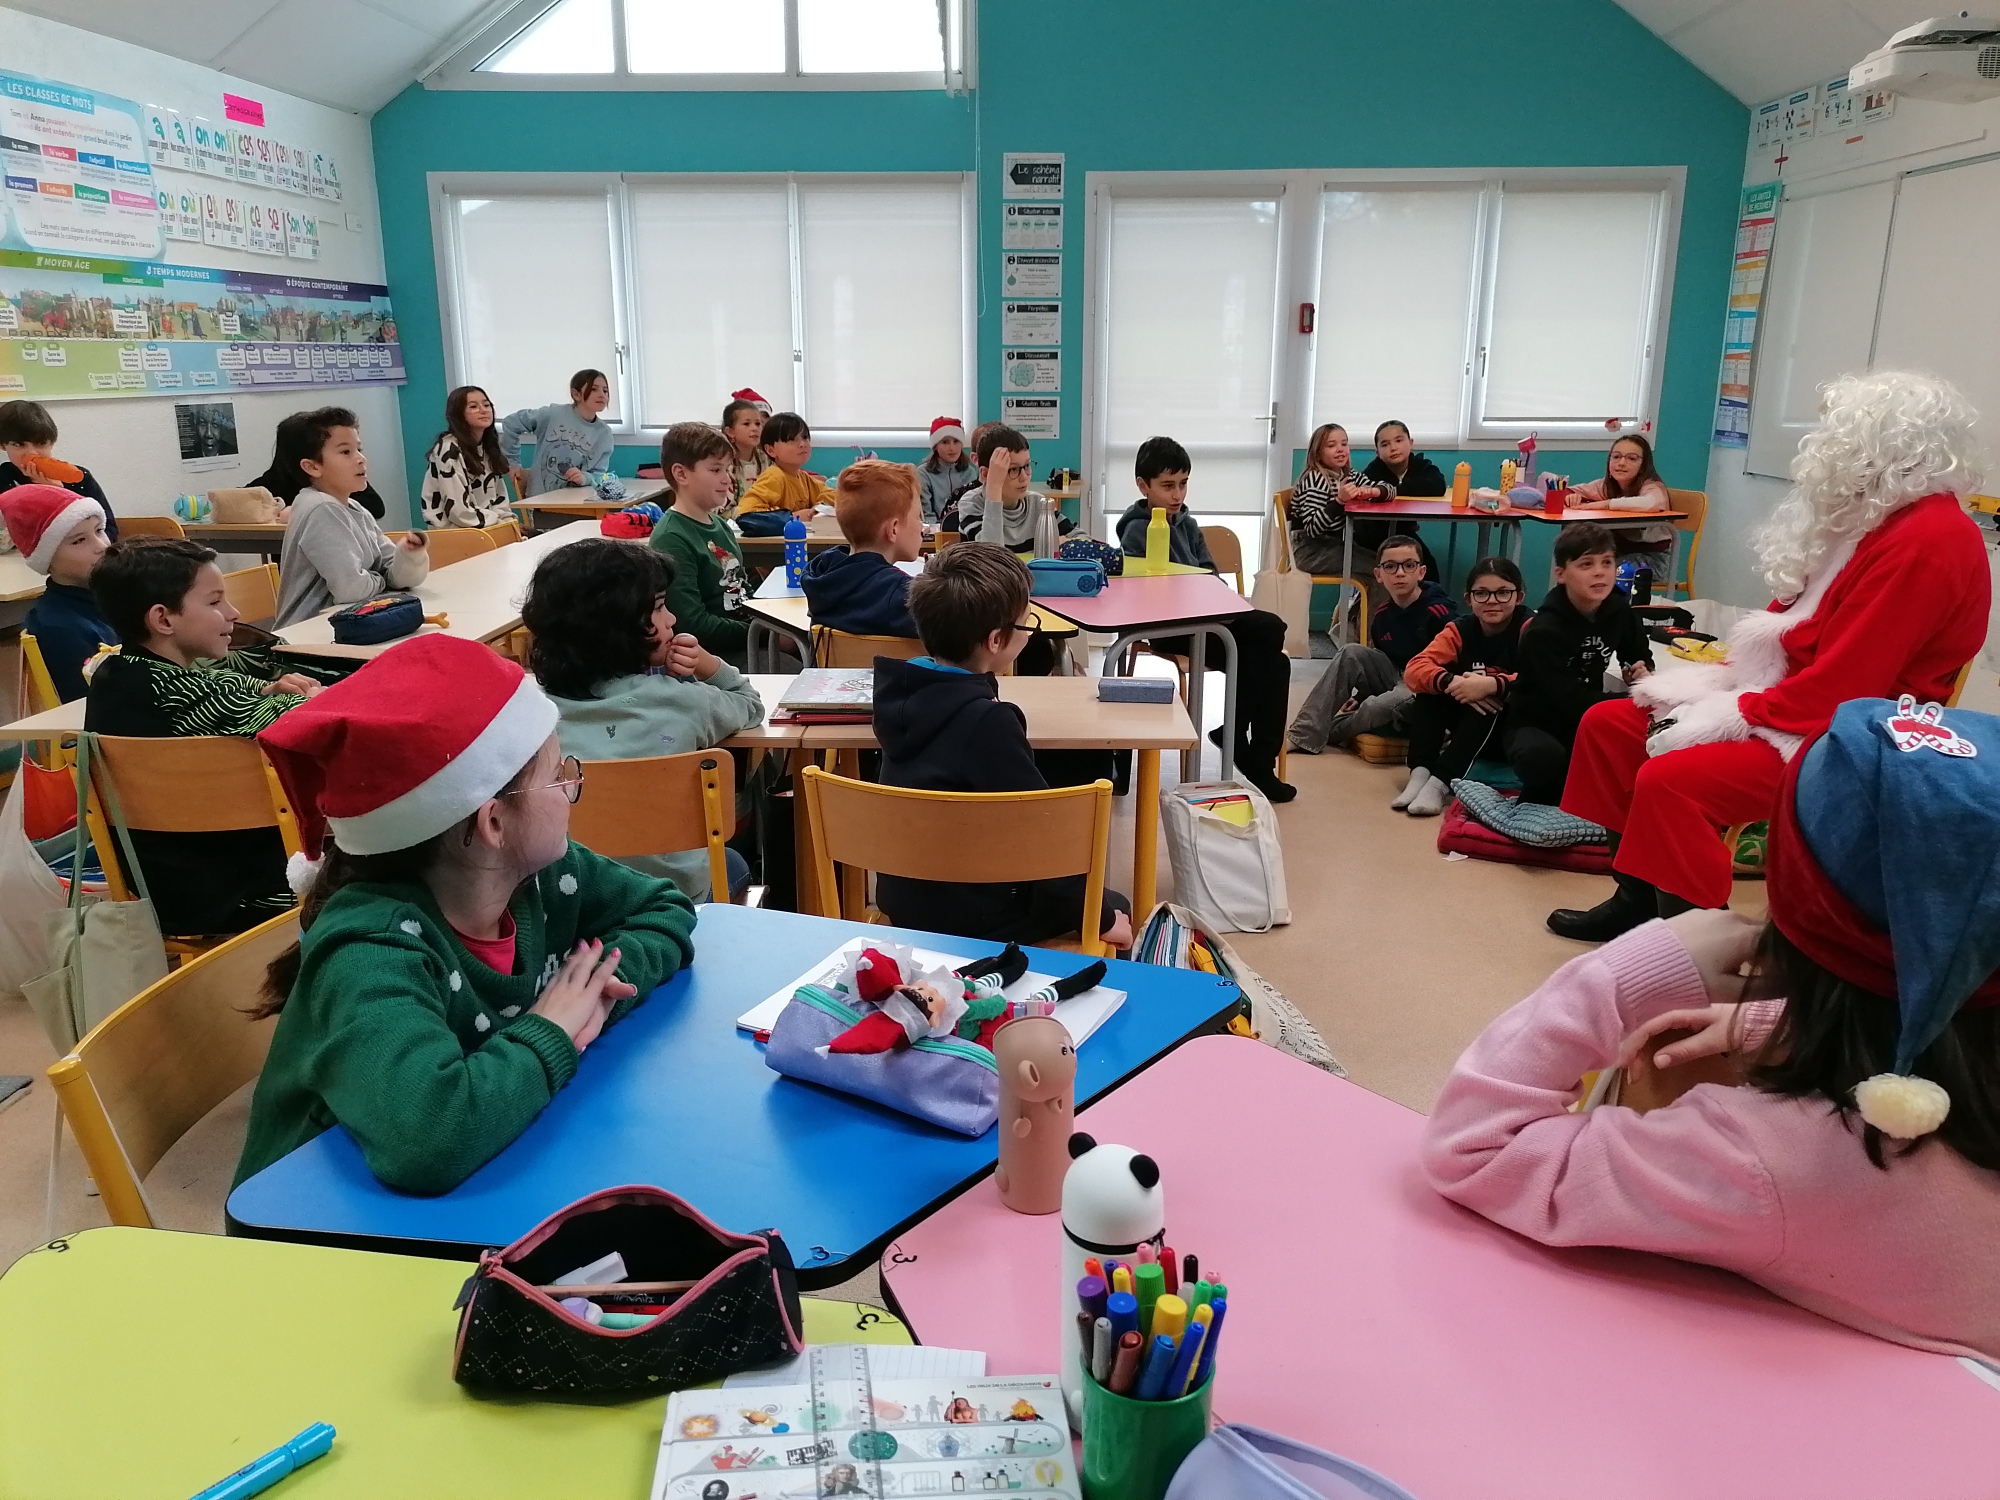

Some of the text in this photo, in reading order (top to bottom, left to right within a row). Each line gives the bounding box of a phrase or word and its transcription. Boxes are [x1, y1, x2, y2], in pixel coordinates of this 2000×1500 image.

[7, 82, 92, 110] LES CLASSES DE MOTS
[30, 113, 46, 123] Anna
[152, 114, 186, 146] a à
[195, 126, 233, 153] on ont
[238, 134, 254, 156] ces
[257, 138, 272, 162] ses
[1018, 164, 1060, 175] Le schéma
[1032, 174, 1060, 183] narratif
[159, 191, 176, 210] ou
[206, 194, 219, 219] et
[250, 205, 280, 231] ce se
[44, 258, 72, 269] MOYEN
[153, 267, 210, 280] TEMPS MODERNES
[291, 278, 310, 288] ÉPOQUE
[1216, 980, 1234, 988] 5
[48, 1239, 70, 1253] 5
[810, 1246, 831, 1261] 3
[891, 1253, 918, 1264] 3
[856, 1313, 880, 1331] 3
